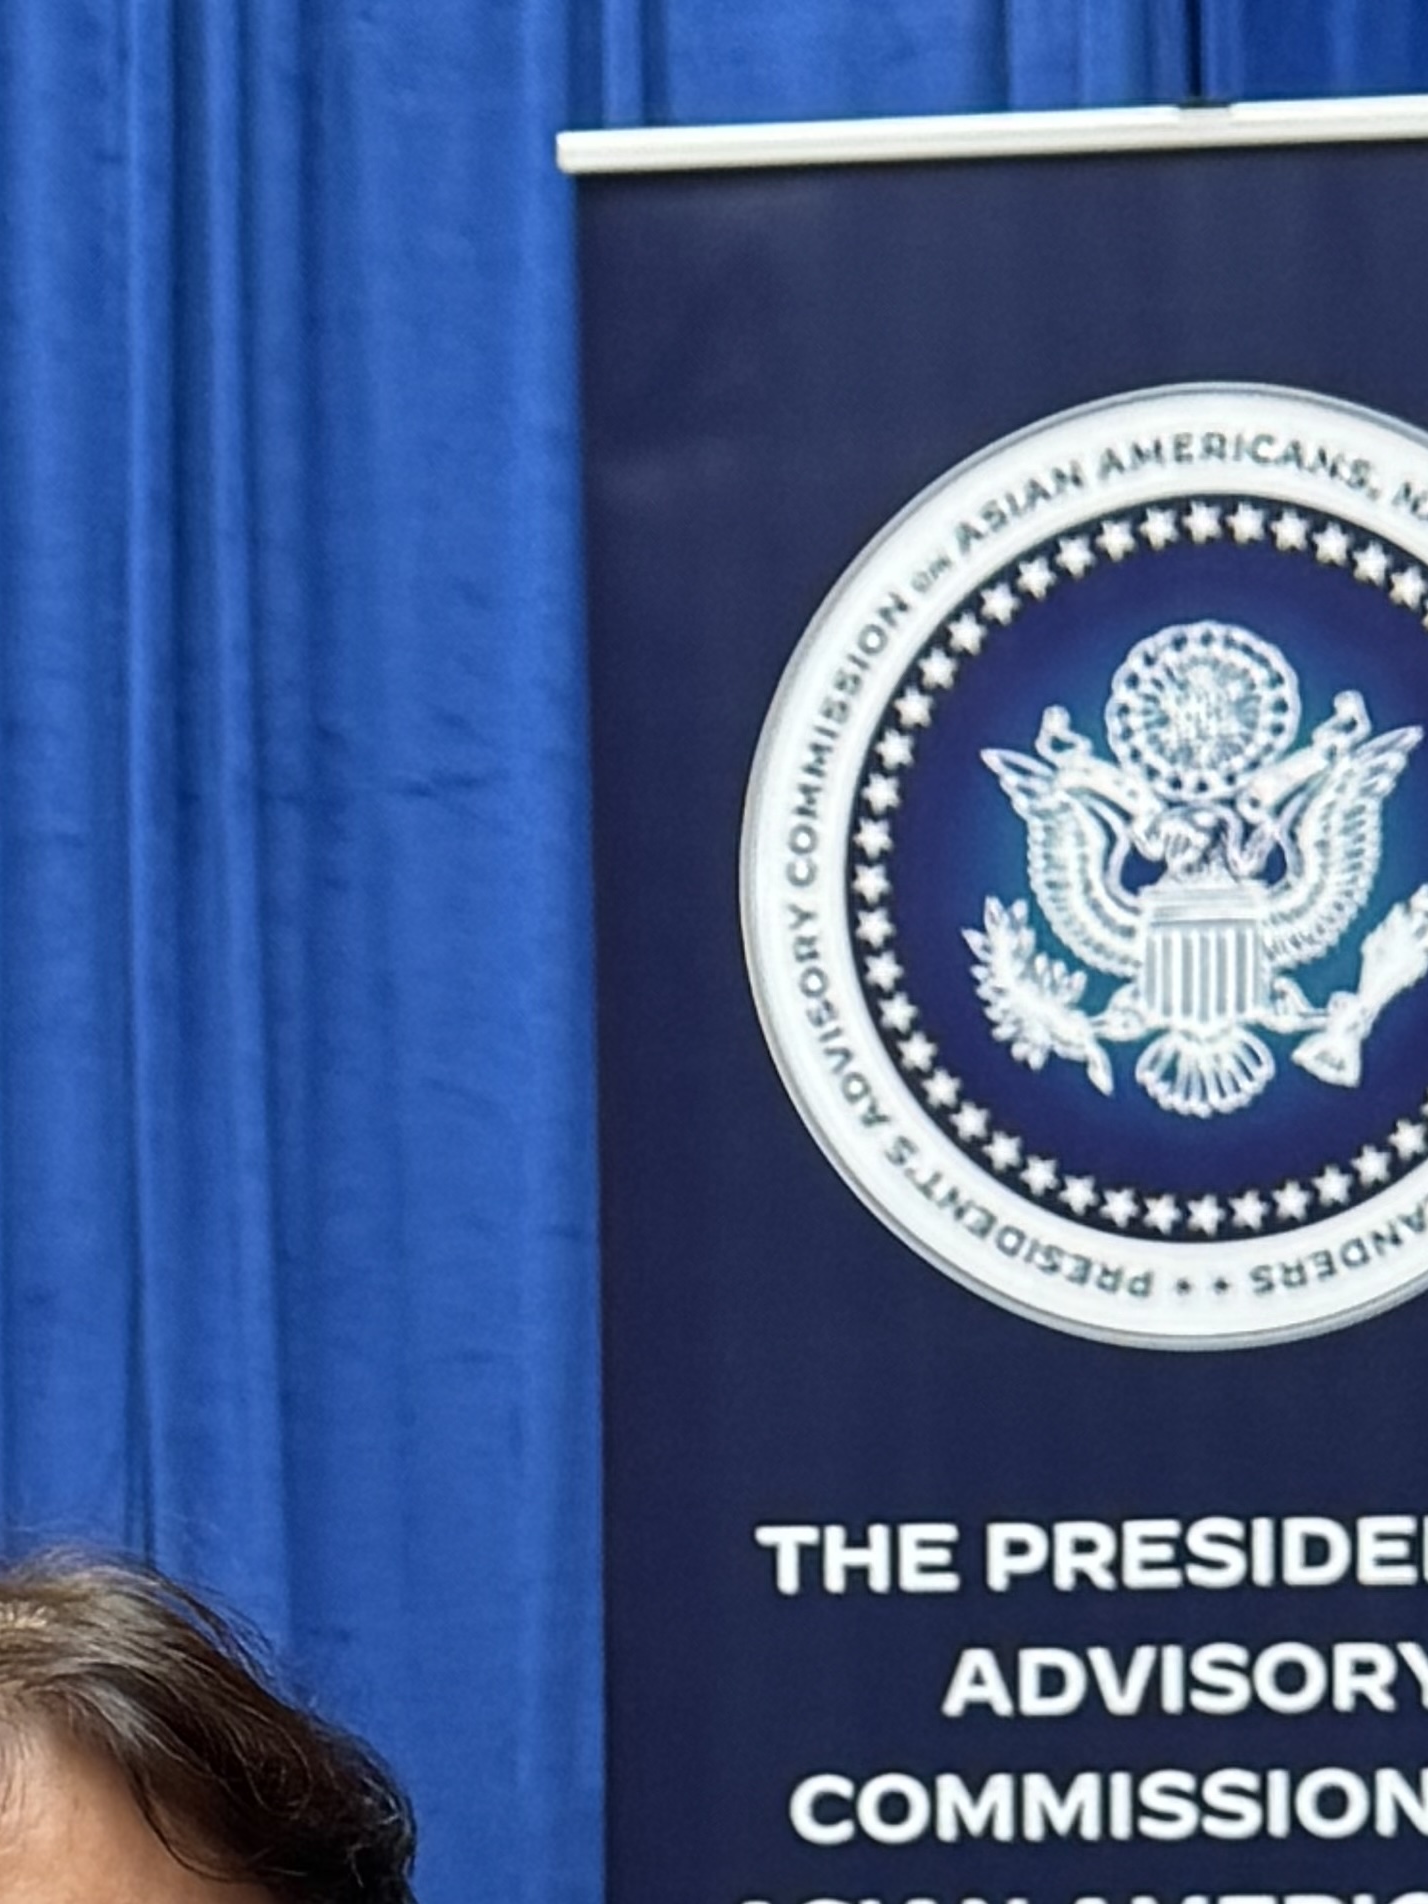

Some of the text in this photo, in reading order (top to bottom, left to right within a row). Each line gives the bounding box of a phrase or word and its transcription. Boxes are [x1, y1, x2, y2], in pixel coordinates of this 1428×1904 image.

[954, 459, 1084, 557] ASIAN
[1096, 432, 1380, 501] AMERICANS,
[786, 591, 910, 887] COMMISSION
[789, 904, 891, 1128] ADVISORY
[884, 1135, 1153, 1298] PRESIDENT'S
[753, 1521, 962, 1596] THE
